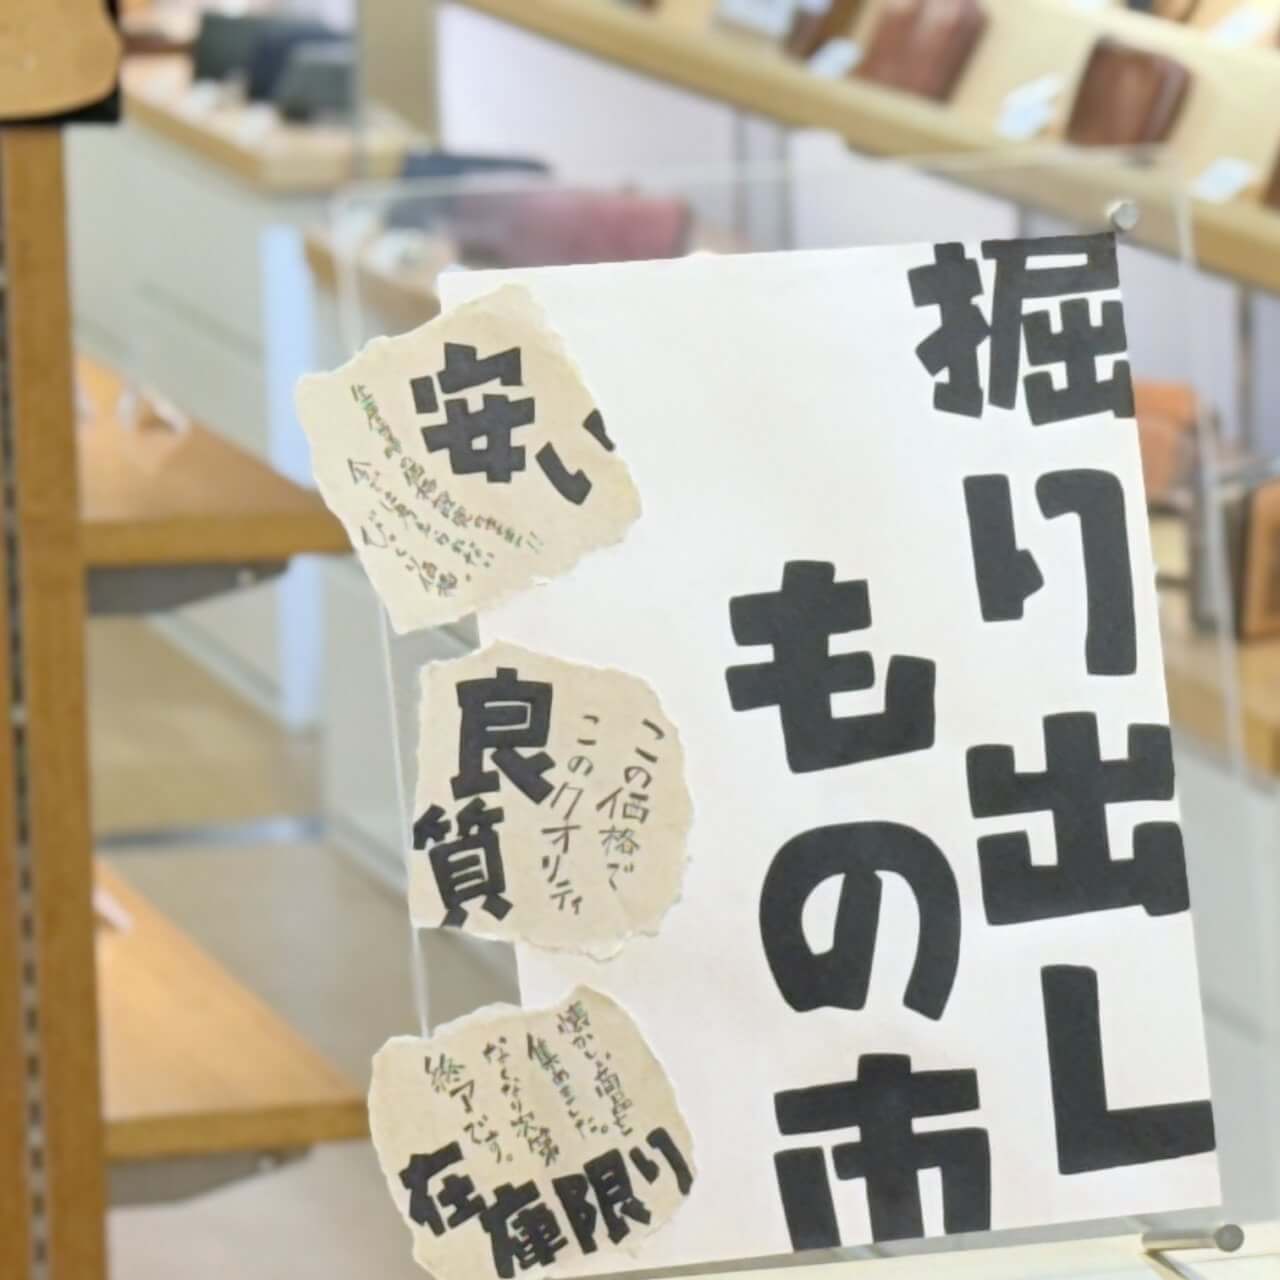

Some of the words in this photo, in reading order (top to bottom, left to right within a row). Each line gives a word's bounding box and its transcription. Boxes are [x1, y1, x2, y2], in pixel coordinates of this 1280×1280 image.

[410, 342, 617, 505] 安い
[413, 666, 556, 929] 良質
[906, 232, 1216, 1175] 掘り出し
[541, 714, 600, 917] このクオリティ
[596, 718, 666, 892] この価格で
[725, 559, 992, 1252] もの市
[424, 1052, 514, 1164] 終了です。
[398, 1126, 694, 1280] 在庫限り
